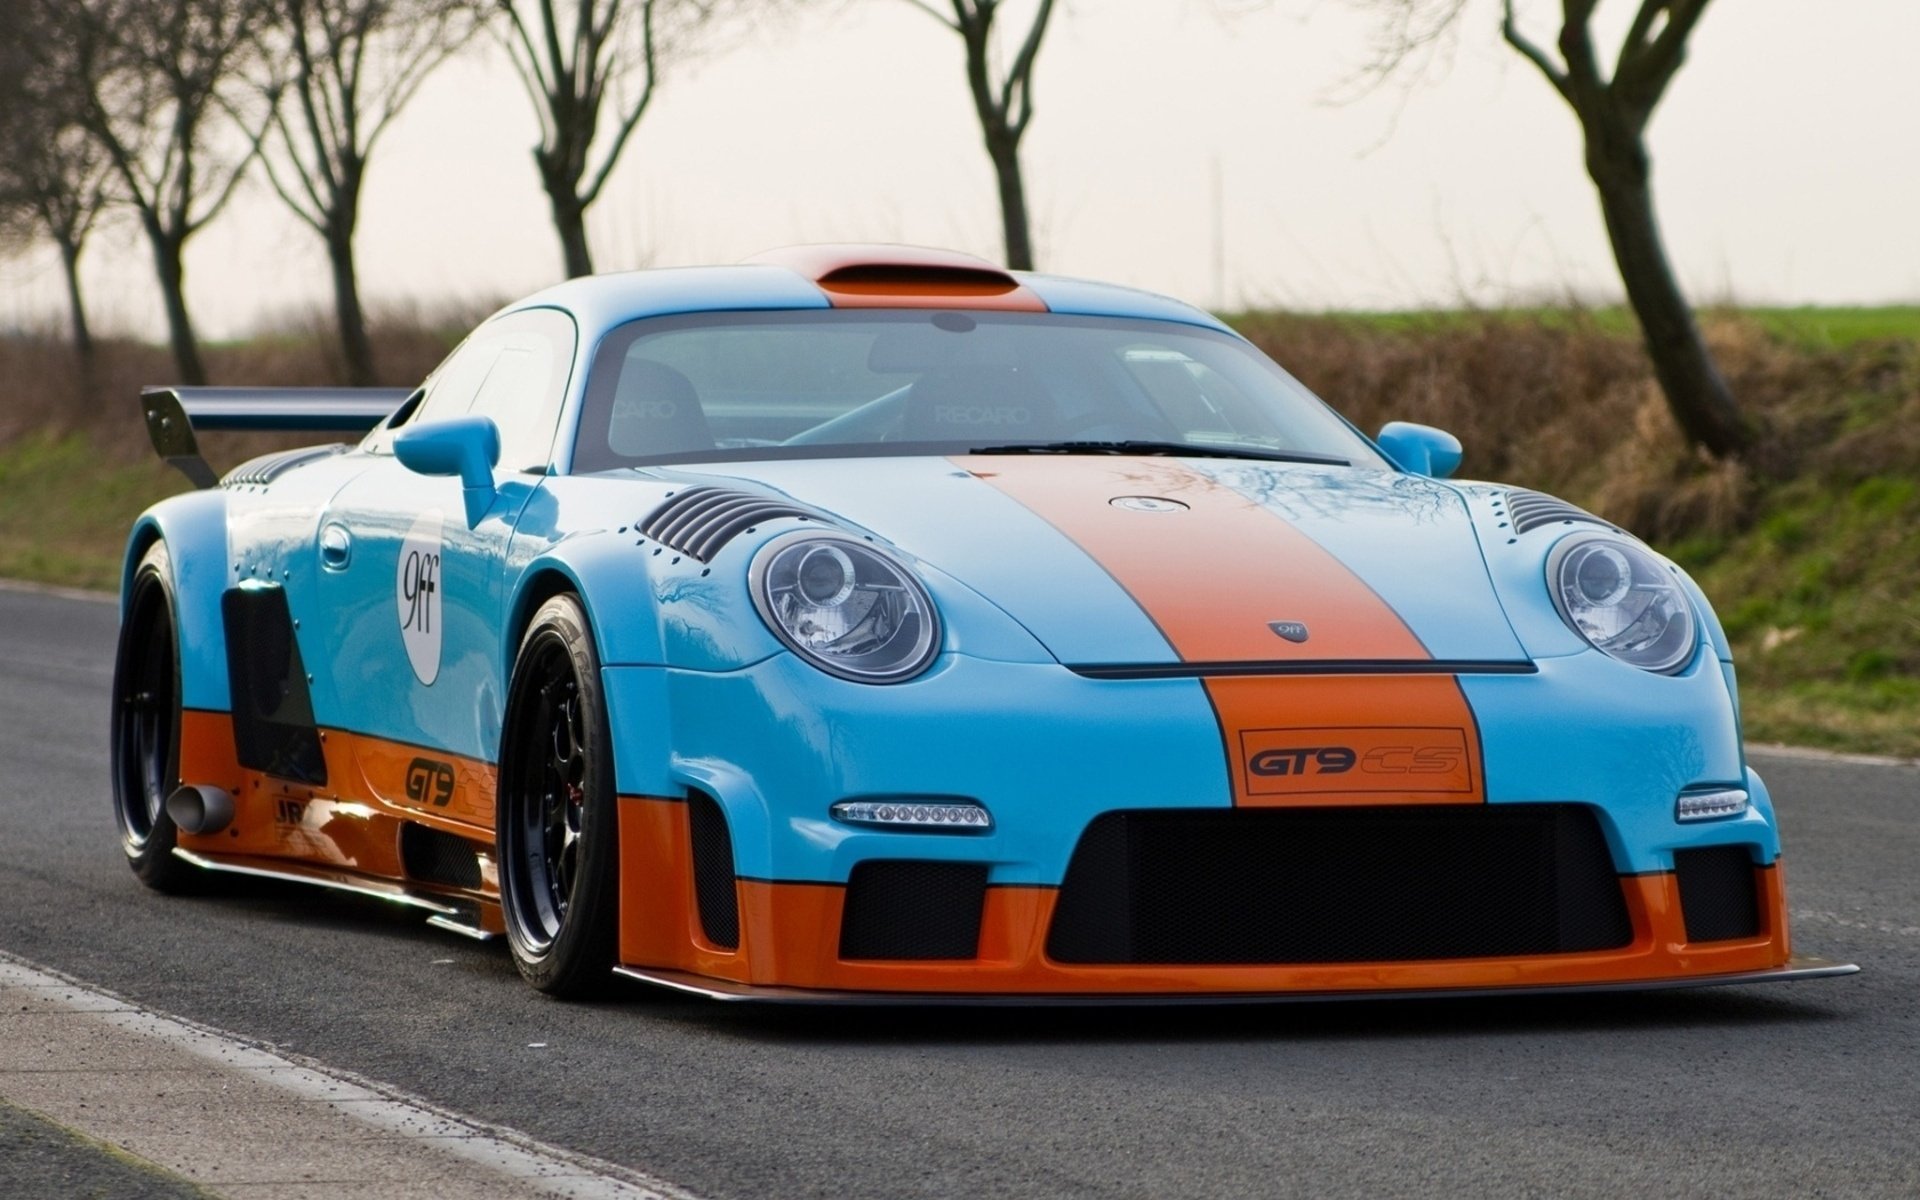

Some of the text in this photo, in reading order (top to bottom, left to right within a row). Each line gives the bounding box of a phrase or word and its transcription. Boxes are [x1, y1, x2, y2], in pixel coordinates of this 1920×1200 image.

[934, 405, 1031, 424] RECARO
[403, 550, 439, 634] 9ff
[1249, 746, 1463, 776] GT9 CS
[406, 757, 455, 807] GT9
[275, 799, 306, 825] JR
